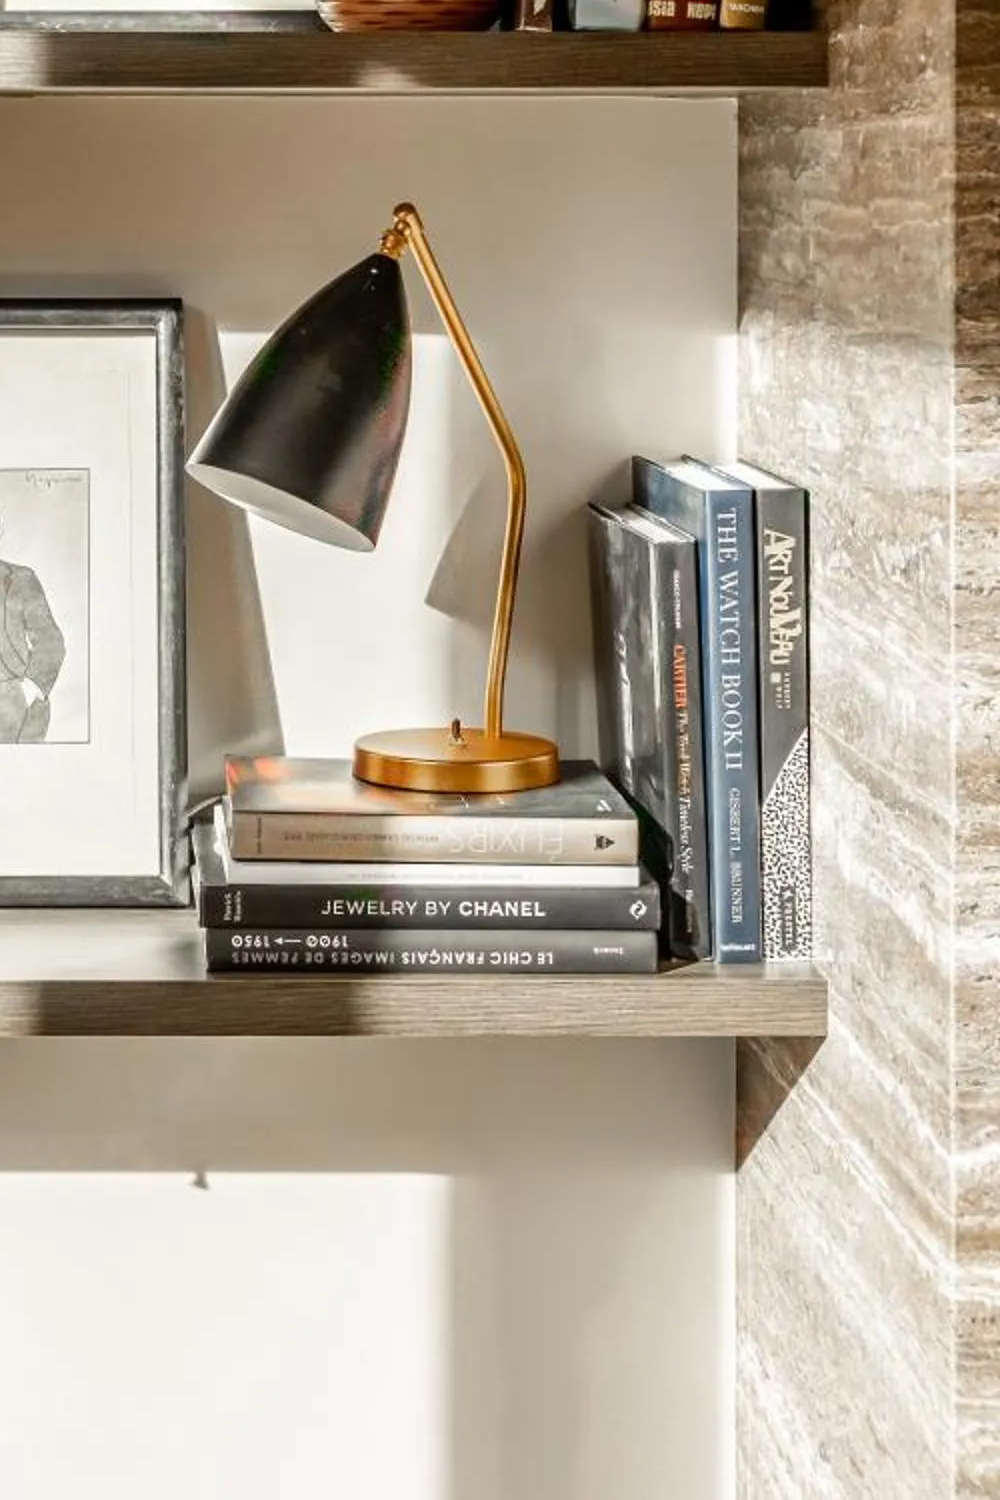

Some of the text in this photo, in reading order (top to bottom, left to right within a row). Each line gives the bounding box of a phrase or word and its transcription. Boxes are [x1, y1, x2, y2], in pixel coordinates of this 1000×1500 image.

[764, 528, 803, 665] ART NOUVEAU
[716, 508, 743, 771] THE WATCH BOOK II
[672, 644, 688, 709] CARTIER
[679, 796, 692, 845] Timeless
[728, 788, 742, 841] GISBERT
[445, 817, 565, 862] ÉLIXIRS
[679, 846, 694, 874] Style
[321, 899, 547, 918] JEWELRY BY CHANEL
[729, 861, 743, 924] BRUNNER
[231, 935, 349, 948] 1900 1950
[231, 948, 554, 965] LE CHIC FRANÇAIS IMAGES DE FEMMES
